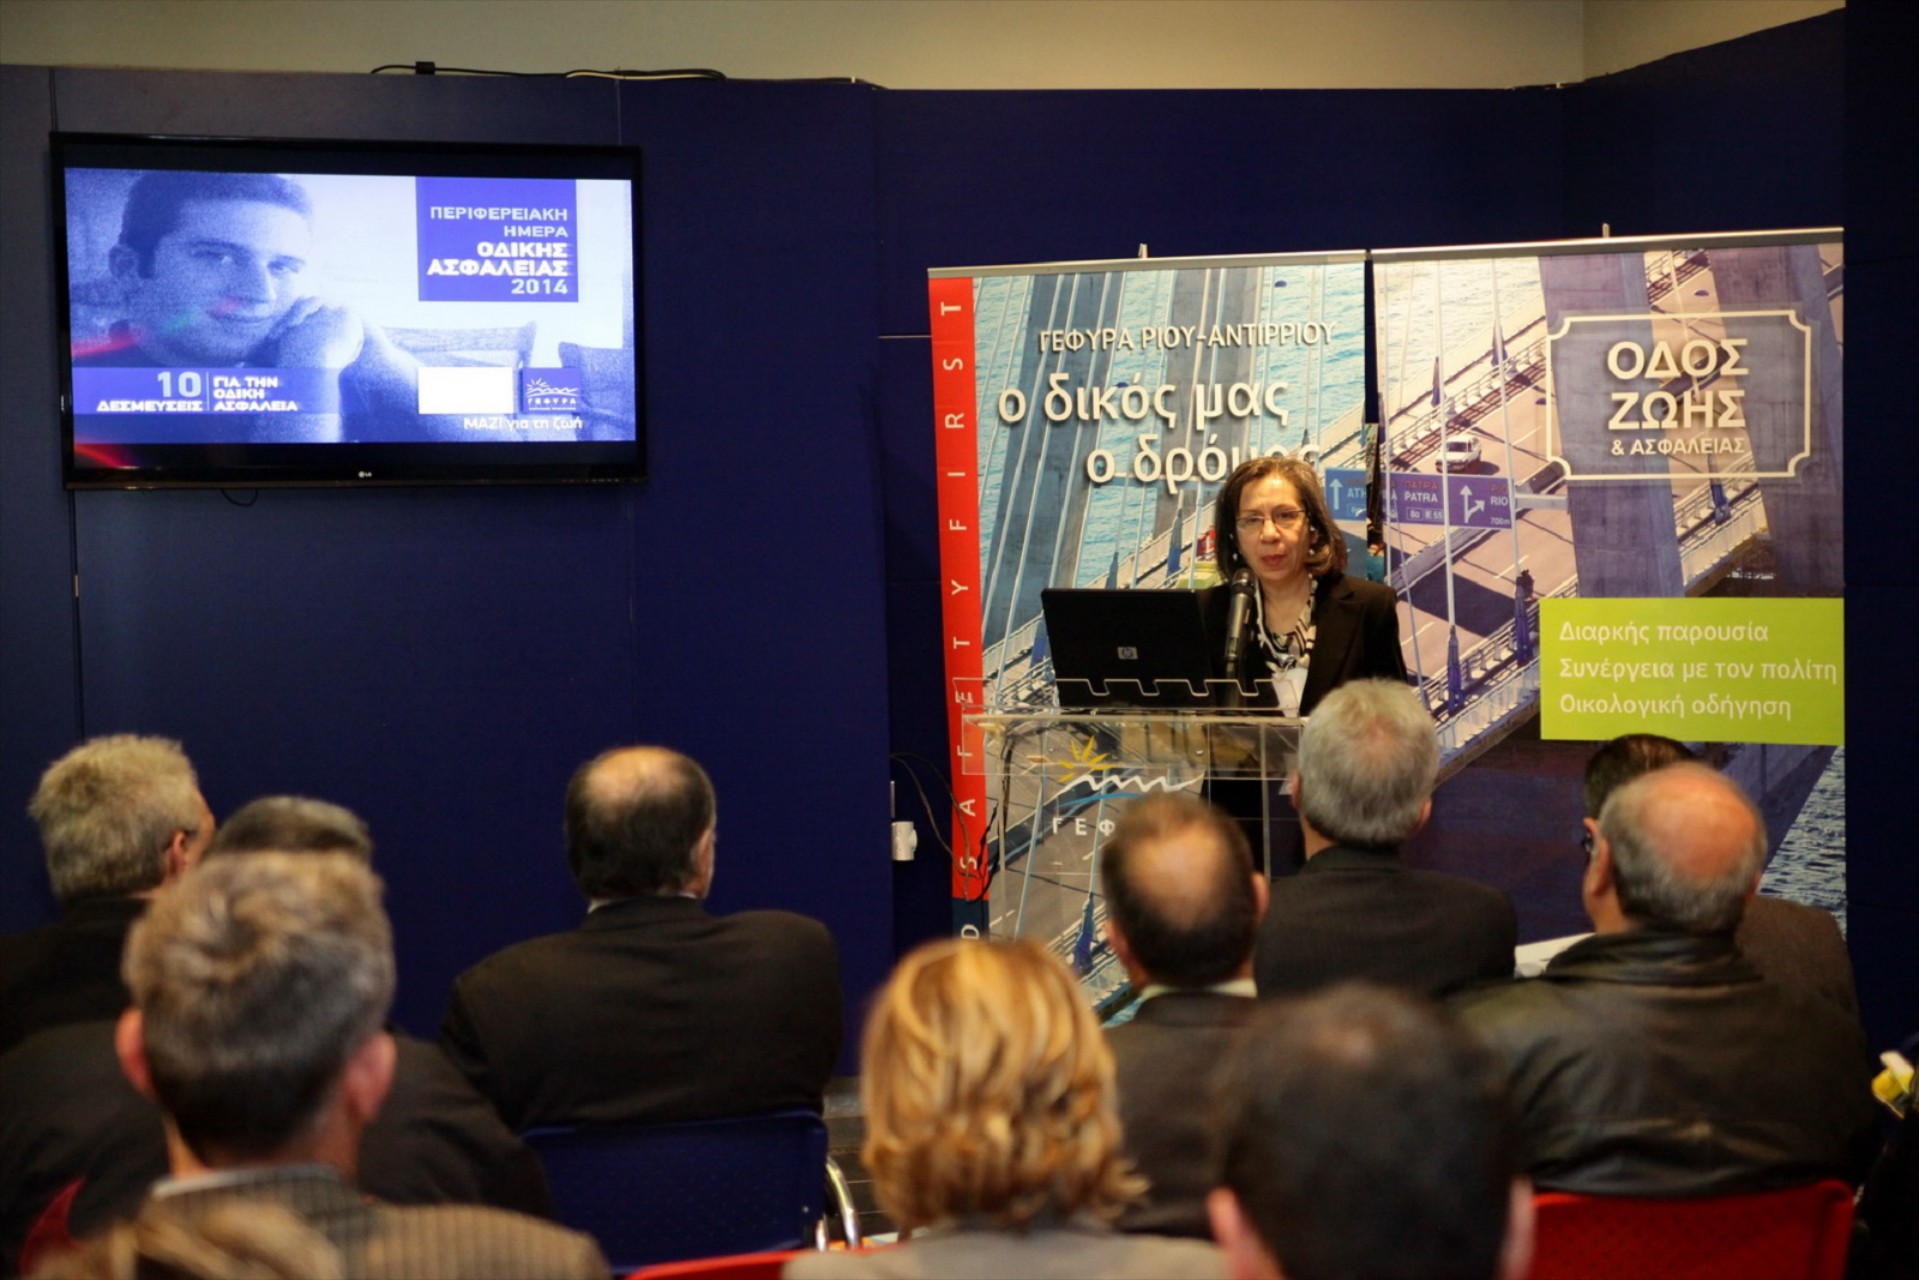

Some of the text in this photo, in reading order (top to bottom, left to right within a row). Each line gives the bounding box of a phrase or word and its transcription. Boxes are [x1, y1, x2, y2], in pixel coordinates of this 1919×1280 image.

[430, 206, 568, 221] ΠΕΡΙΦΕΡΕΙΑΚΗ
[504, 225, 569, 238] ΗΜΕΡΑ
[477, 241, 568, 258] ΟΔΙΚΗΣ
[427, 258, 569, 276] ΑΣΦΑΛΕΙΑΣ
[511, 278, 568, 294] 2014
[1039, 328, 1135, 353] ΓΕΦΥΡΑ
[1607, 338, 1749, 380] ΟΔΟΣ
[157, 371, 202, 398] 10
[213, 376, 279, 388] ΓΙΑ ΤΗΝ
[213, 388, 265, 399] ΟΔΙΚΗ
[999, 371, 1289, 430] ο δικός μας
[96, 400, 203, 412] ΔΕΣΜΕΥΣΕΙΣ
[213, 400, 298, 412] ΑΣΦΑΛΕΙΑ
[1608, 389, 1746, 430] ΖΩΗΣ
[940, 300, 968, 532] FIRST
[1611, 437, 1746, 456] & ΑΣΦΑΛΕΙΑΣ
[1086, 449, 1116, 483] ο
[1404, 490, 1439, 503] PATRA
[1490, 495, 1509, 506] RIO
[1559, 620, 1769, 645] Διαρκής παρουσία
[1559, 658, 1838, 685] Συνέργεια με τον πολίτη
[1560, 693, 1792, 721] Οικολογική οδήγηση
